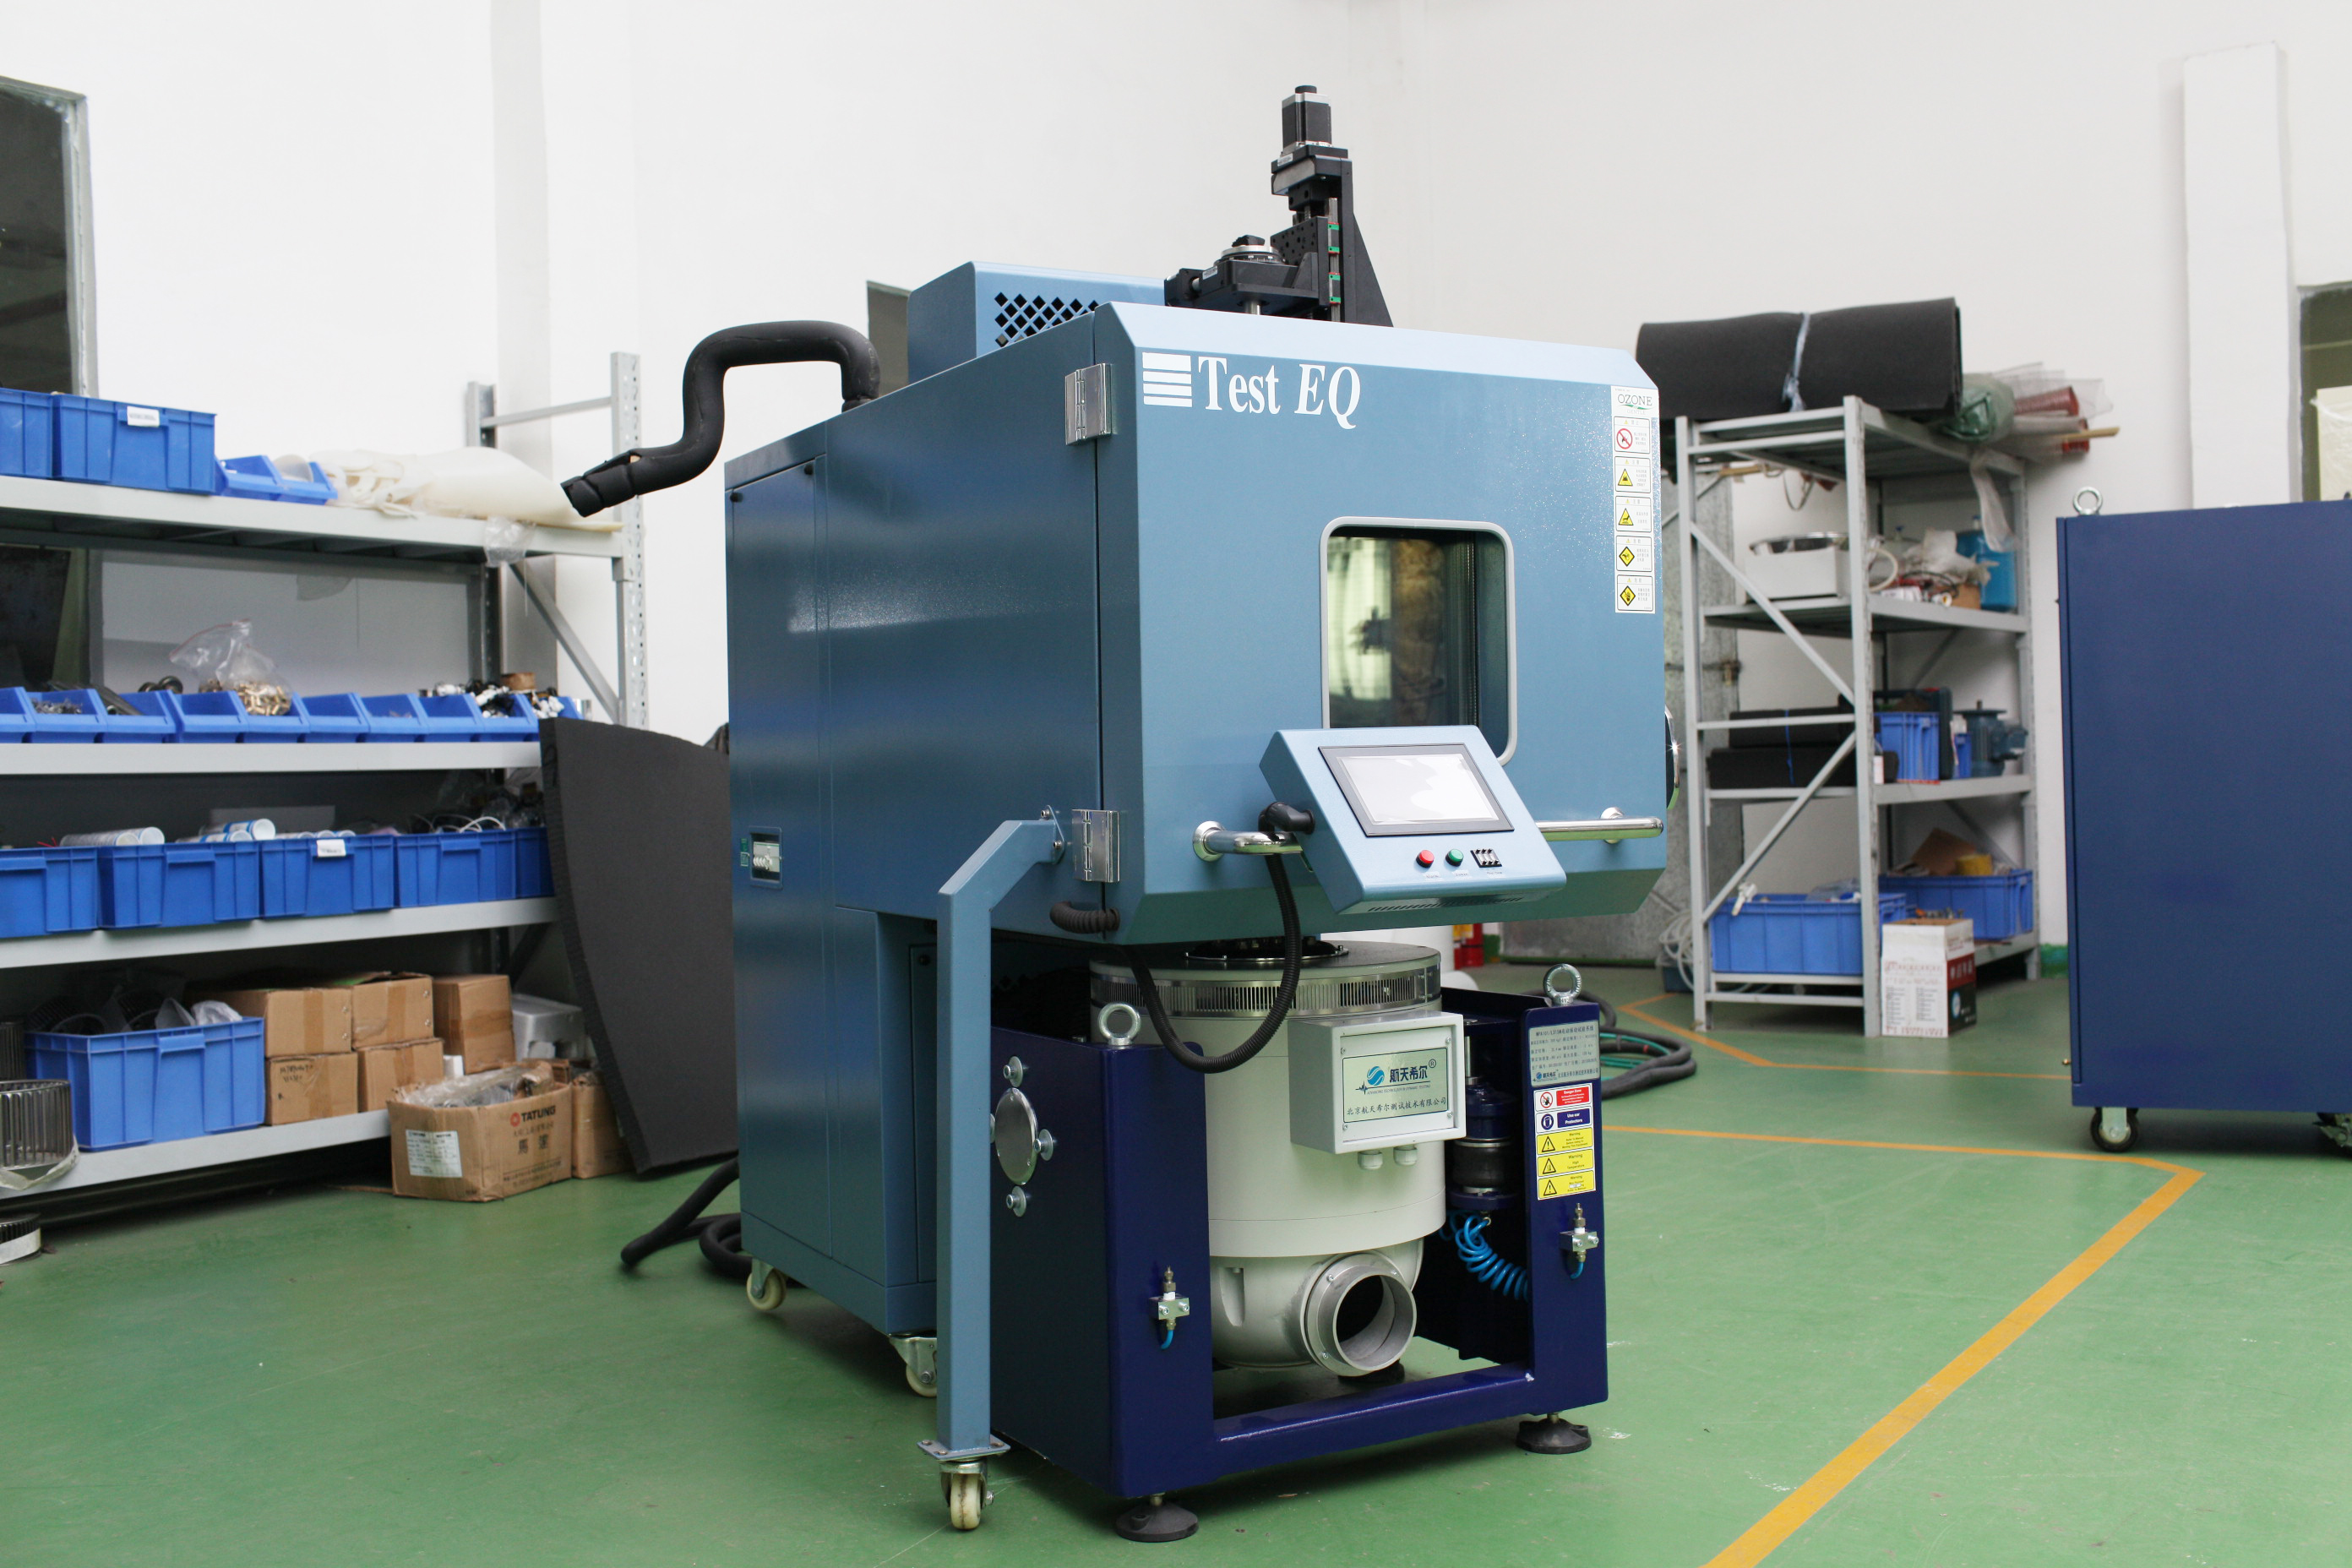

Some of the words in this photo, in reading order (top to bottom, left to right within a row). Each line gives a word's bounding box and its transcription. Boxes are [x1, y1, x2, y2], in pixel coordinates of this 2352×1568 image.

[1198, 356, 1282, 415] Test
[1293, 363, 1361, 430] EQ
[1617, 394, 1652, 406] OZONE
[1389, 1065, 1428, 1083] 航天希尔
[521, 1105, 556, 1122] TATUNG
[1347, 1097, 1446, 1115] 北京航天希尔测试技术有限公司
